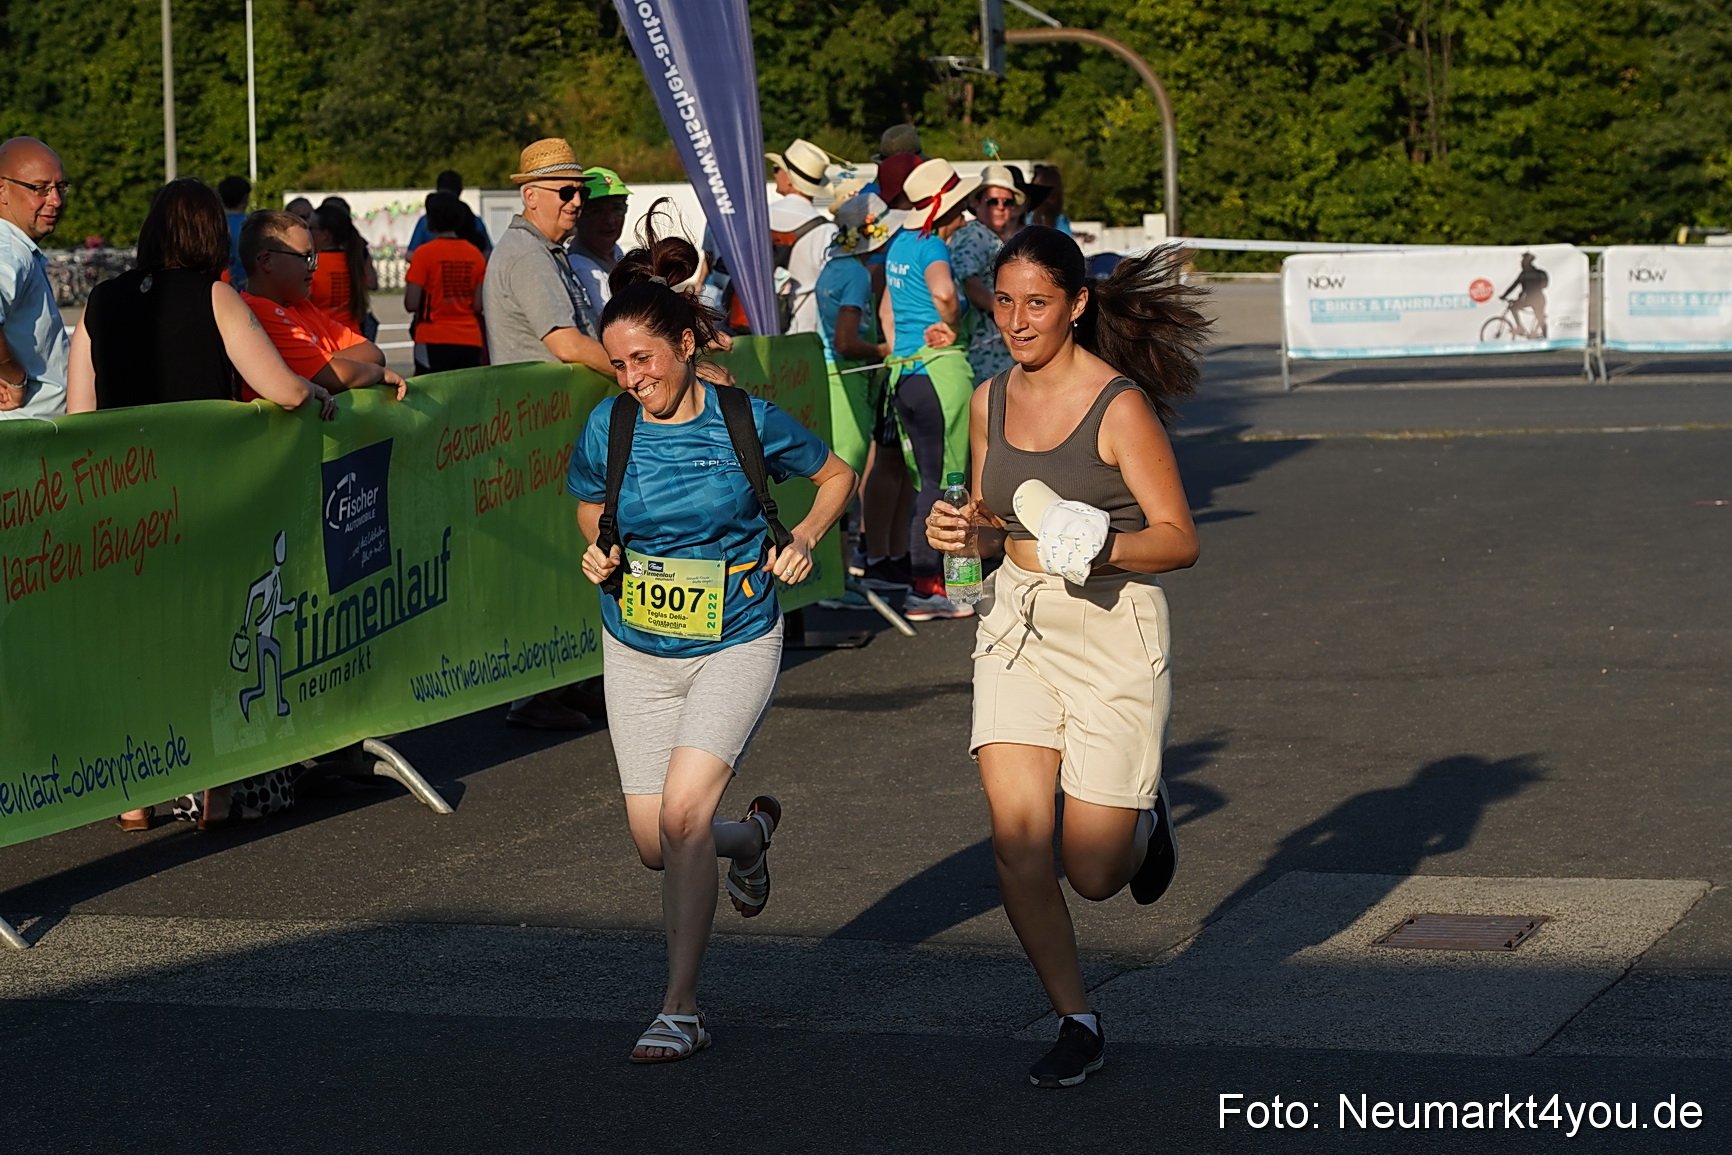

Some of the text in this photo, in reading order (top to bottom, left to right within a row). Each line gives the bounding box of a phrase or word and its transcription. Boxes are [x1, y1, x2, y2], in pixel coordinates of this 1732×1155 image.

[1307, 276, 1345, 290] NOW
[1629, 269, 1667, 283] NOW
[1311, 299, 1368, 313] E-BIKES
[1370, 298, 1382, 311] &
[436, 391, 572, 471] Gesunde Firmen
[0, 446, 157, 530] unde Firmen
[474, 442, 576, 516] laufen länge
[339, 486, 379, 521] Fischer
[3, 486, 181, 604] laufen länger!
[295, 526, 451, 670] firmenlauf
[626, 580, 634, 617] WALK
[636, 581, 705, 613] 1907
[647, 609, 667, 619] Teglas
[706, 593, 718, 629] 2022
[299, 645, 372, 703] neumarkt
[410, 617, 598, 703] www.firmenlauf-oberpfalz.de
